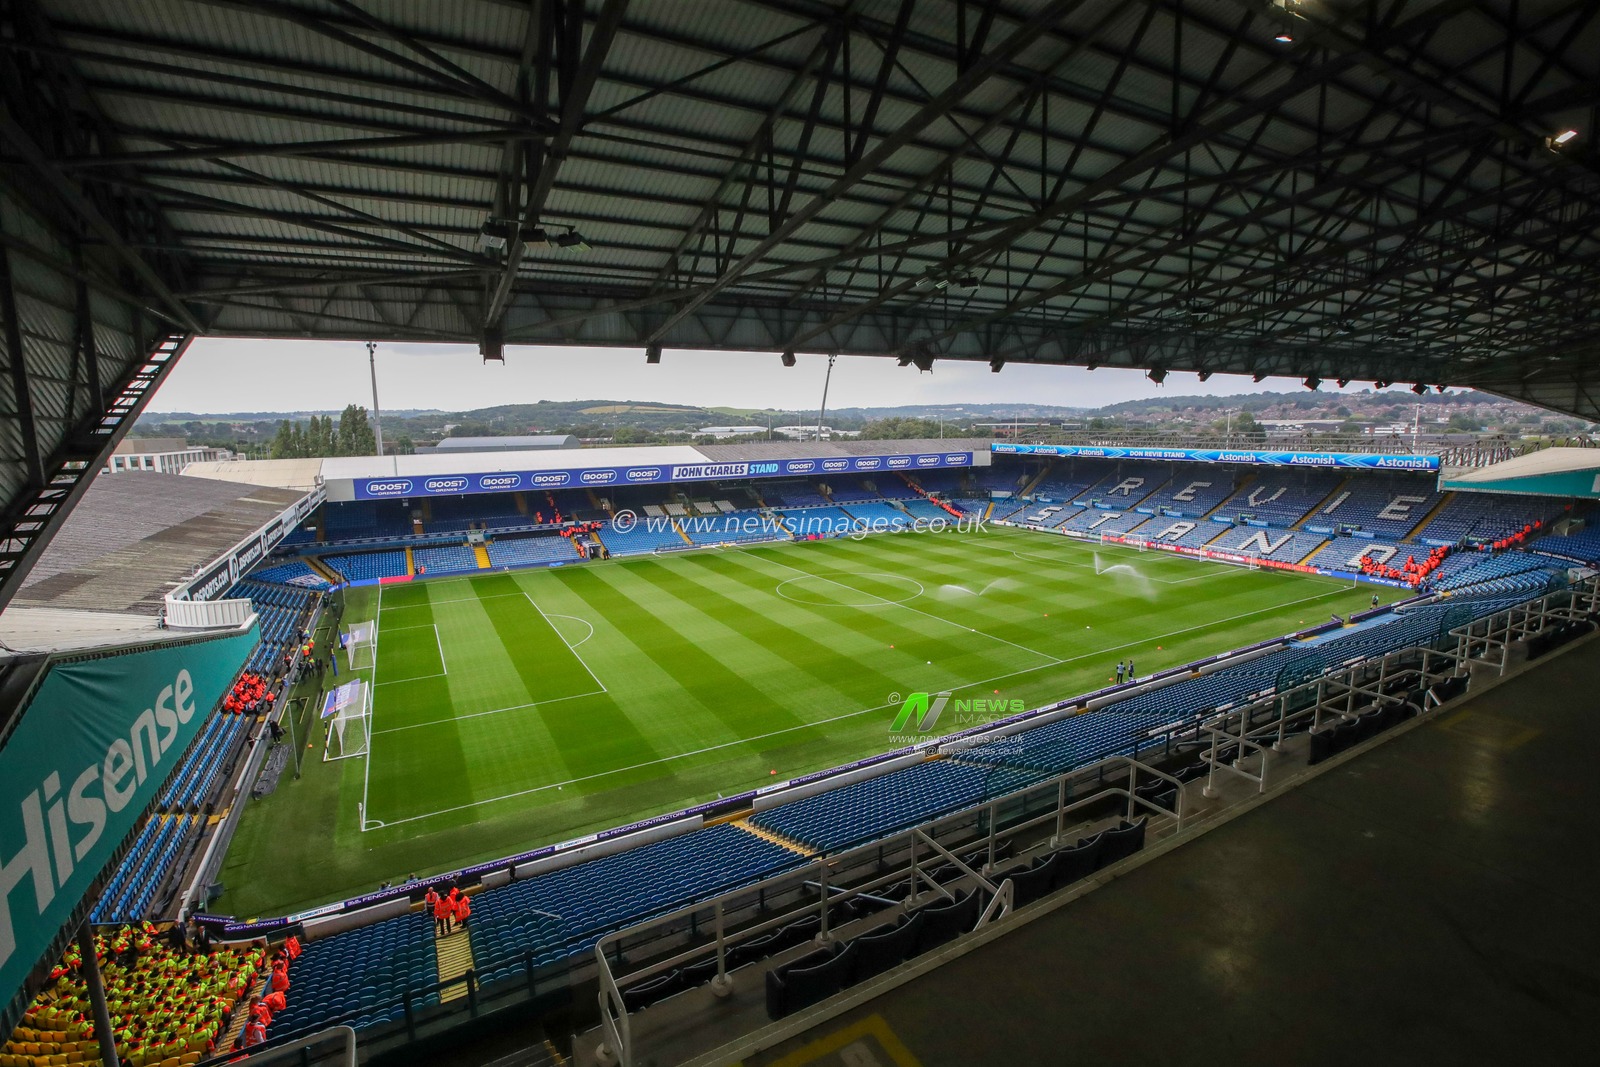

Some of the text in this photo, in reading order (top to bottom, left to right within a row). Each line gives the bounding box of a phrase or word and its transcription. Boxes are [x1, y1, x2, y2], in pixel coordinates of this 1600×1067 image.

[1077, 448, 1104, 456] Astonish
[1144, 450, 1163, 458] REVIE
[1217, 452, 1256, 462] Astonish
[1290, 454, 1336, 465] Astonish
[1376, 456, 1431, 468] Astonish
[629, 470, 658, 478] BOOST
[675, 463, 779, 478] JOHN CHARLES STAND
[534, 475, 567, 483] BOOST
[583, 472, 614, 480] BOOST
[428, 480, 465, 488] BOOST
[483, 477, 517, 485] BOOST
[370, 483, 409, 491] BOOST
[0, 668, 196, 969] Hisense
[610, 811, 686, 838] FENCING CONTRACTORS
[465, 865, 489, 874] FENCING
[362, 888, 399, 903] FENCING
[399, 871, 463, 893] CONTRACTORS
[300, 909, 324, 919] COMMUNITY
